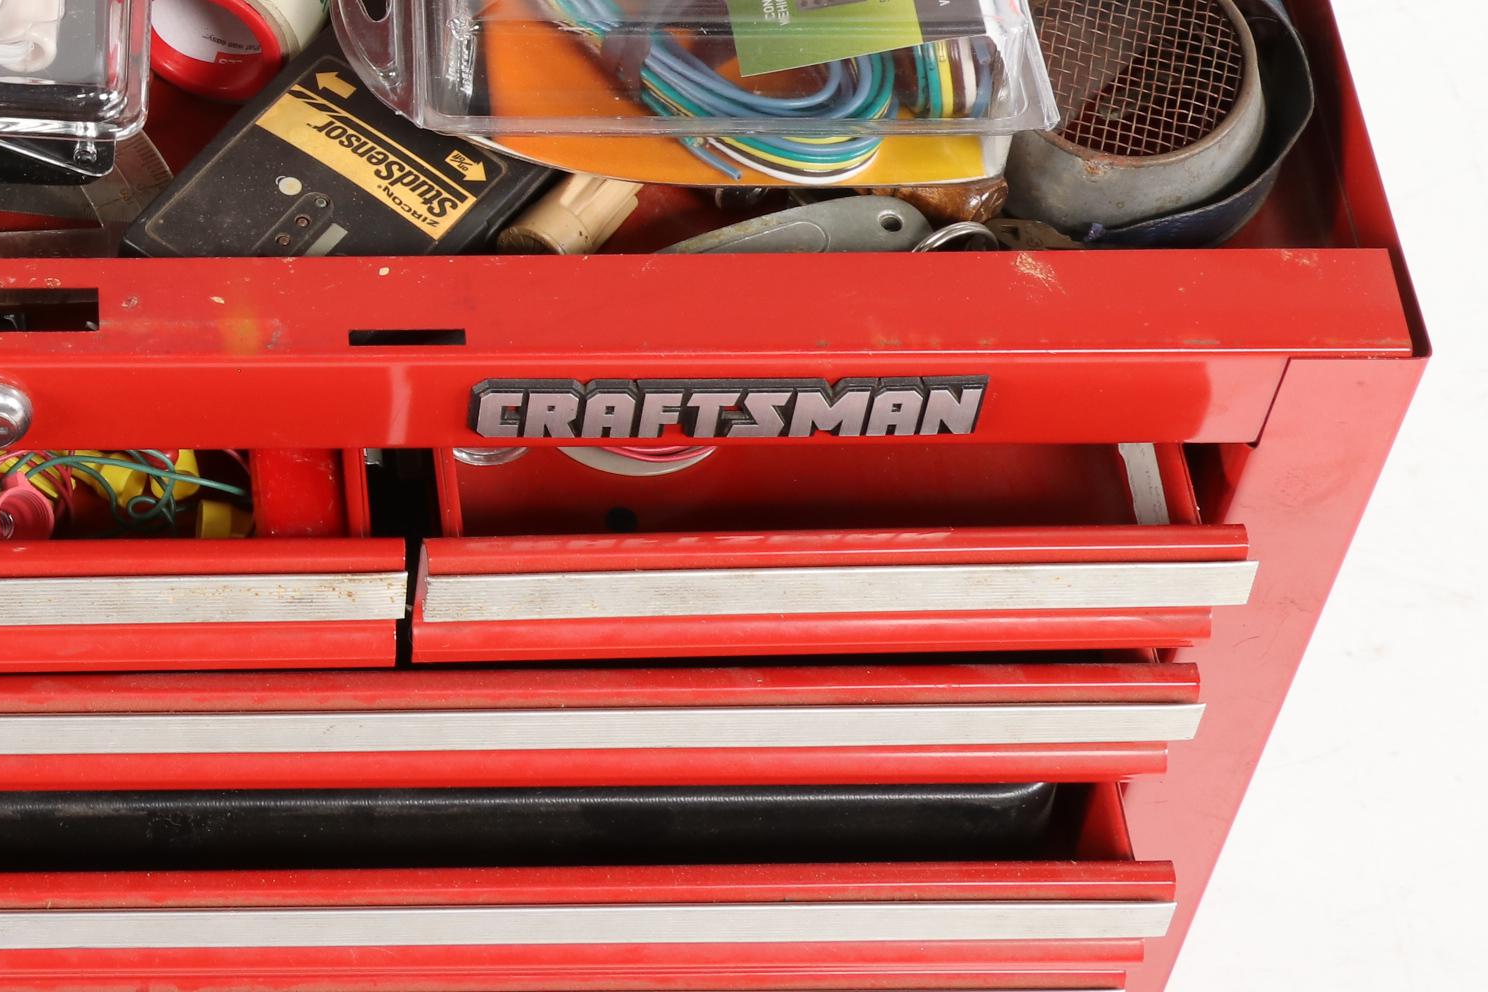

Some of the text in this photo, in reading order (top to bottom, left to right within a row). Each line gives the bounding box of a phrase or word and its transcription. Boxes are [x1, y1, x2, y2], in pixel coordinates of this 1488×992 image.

[313, 120, 459, 219] StudSensor
[383, 184, 440, 228] ZIRCON
[471, 377, 989, 438] CRAFTSMAN
